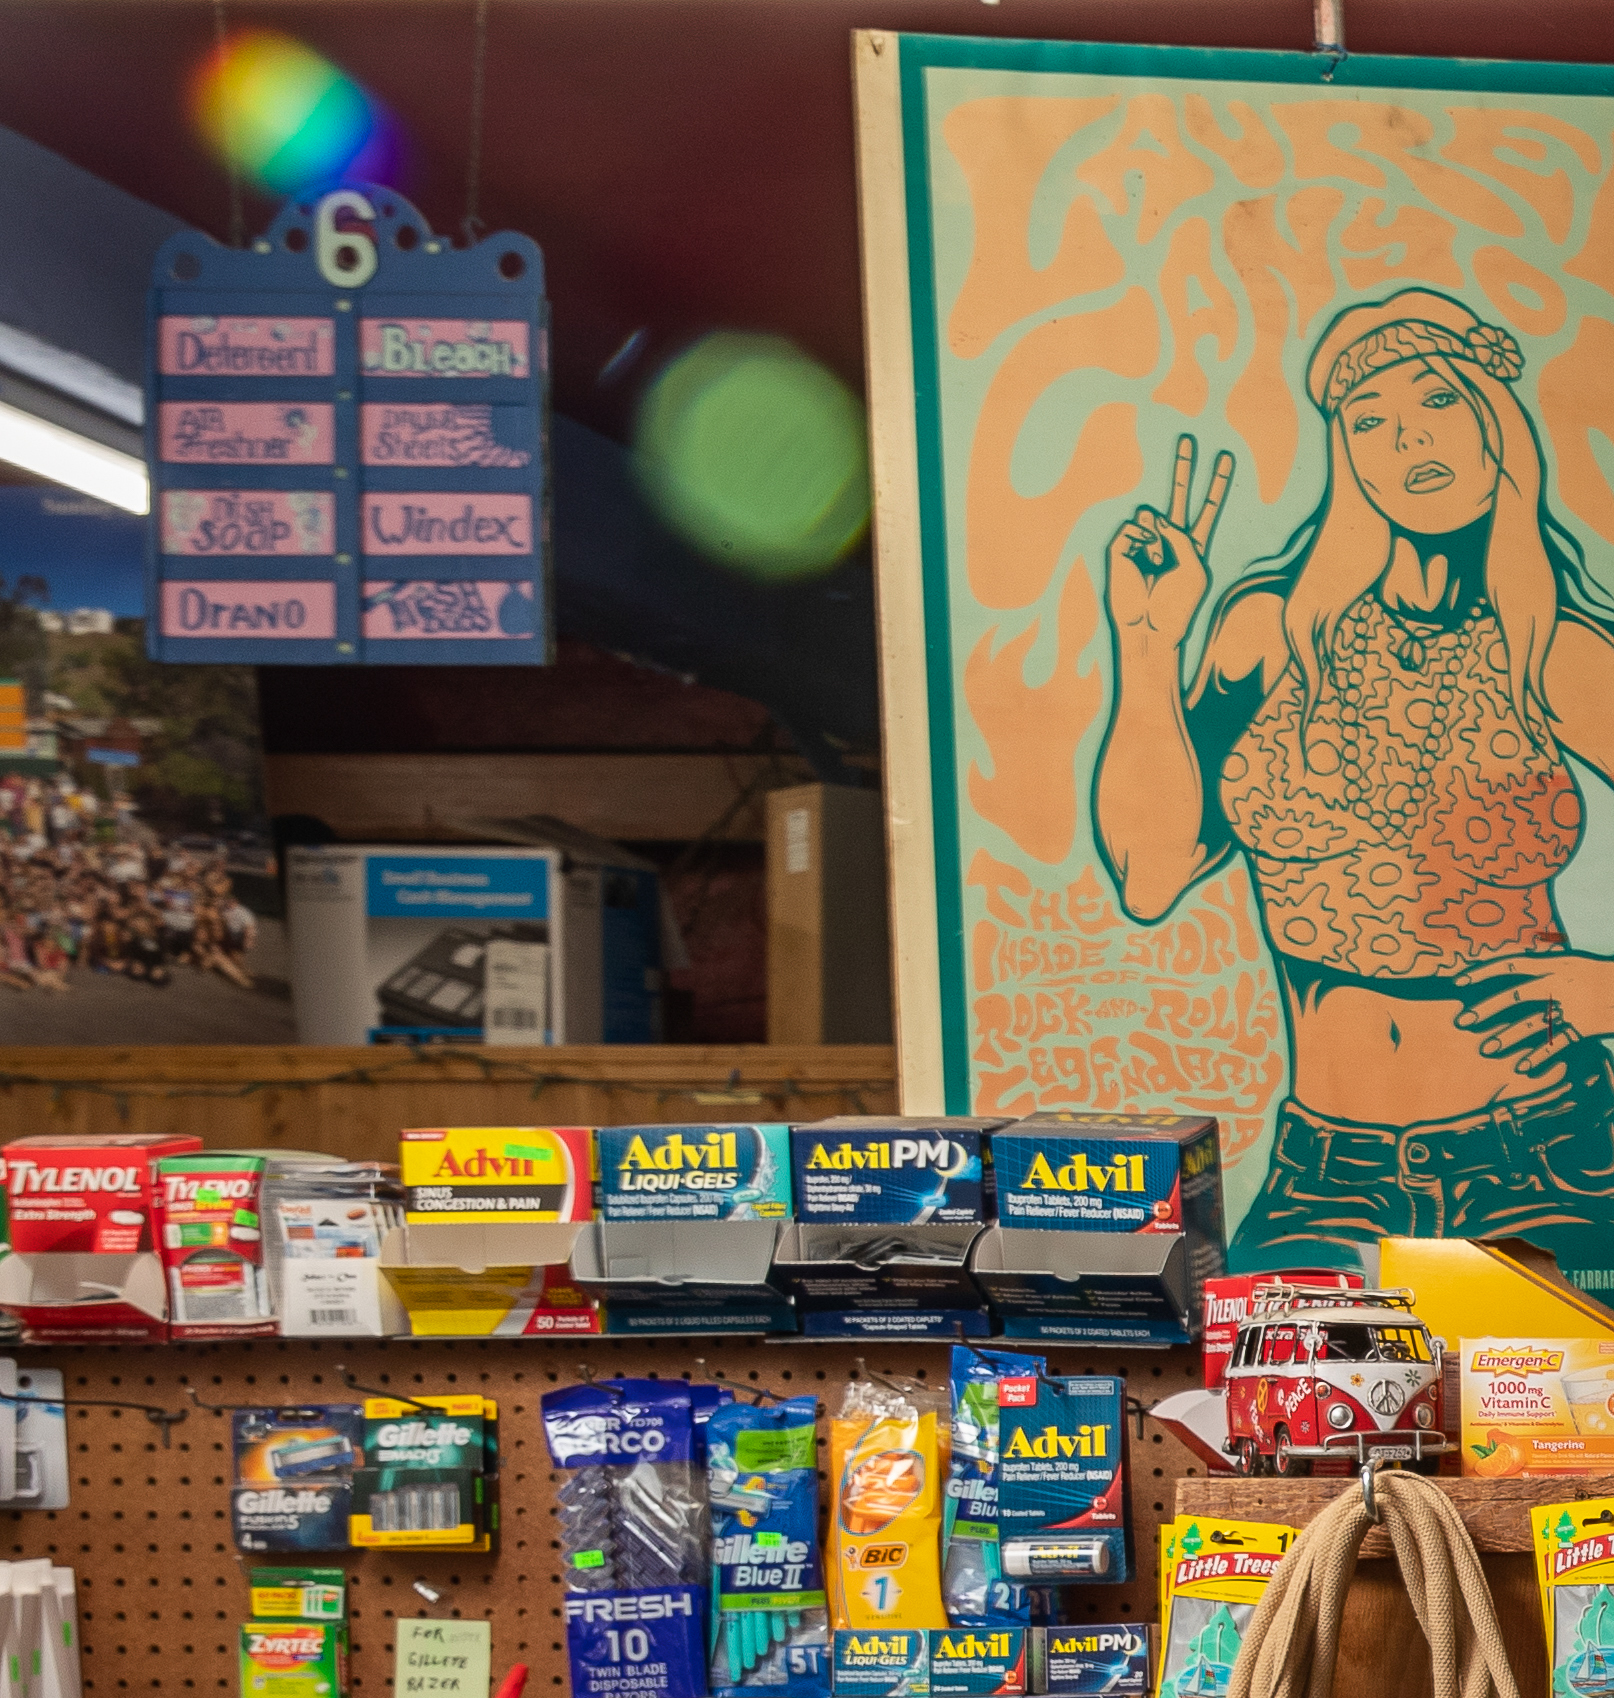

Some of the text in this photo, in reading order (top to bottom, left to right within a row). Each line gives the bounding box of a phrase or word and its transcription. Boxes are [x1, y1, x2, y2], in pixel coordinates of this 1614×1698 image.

[315, 189, 379, 289] 6
[371, 506, 525, 548] Windex
[619, 1132, 738, 1170] Advil
[806, 1139, 949, 1170] Advil PM
[9, 1161, 141, 1195] TYLENOL
[1021, 1151, 1145, 1192] Advil
[416, 1187, 453, 1198] SINUS
[416, 1197, 541, 1211] CONGESTION PAIN
[1205, 1294, 1248, 1326] TYLENOL
[1488, 1381, 1543, 1397] 1,000 mg
[1481, 1396, 1551, 1409] Vitamin C
[377, 1424, 470, 1448] Gillette
[1003, 1425, 1110, 1459] Advil
[1532, 1439, 1585, 1451] Tangerine
[237, 1491, 331, 1515] Gillette
[865, 1547, 904, 1565] BIC
[1555, 1540, 1604, 1573] Little
[735, 1566, 782, 1587] Blue
[1176, 1553, 1279, 1584] Little Trees
[565, 1594, 692, 1623] FRESH
[249, 1635, 325, 1655] ZYRTEC
[412, 1628, 443, 1643] FOR
[604, 1629, 650, 1662] 10
[845, 1636, 908, 1656] Advil
[935, 1635, 1012, 1659] Advil
[1050, 1634, 1131, 1652] Advil PM
[589, 1664, 668, 1677] TWIN BLADE
[590, 1677, 668, 1692] DISPOSABLE
